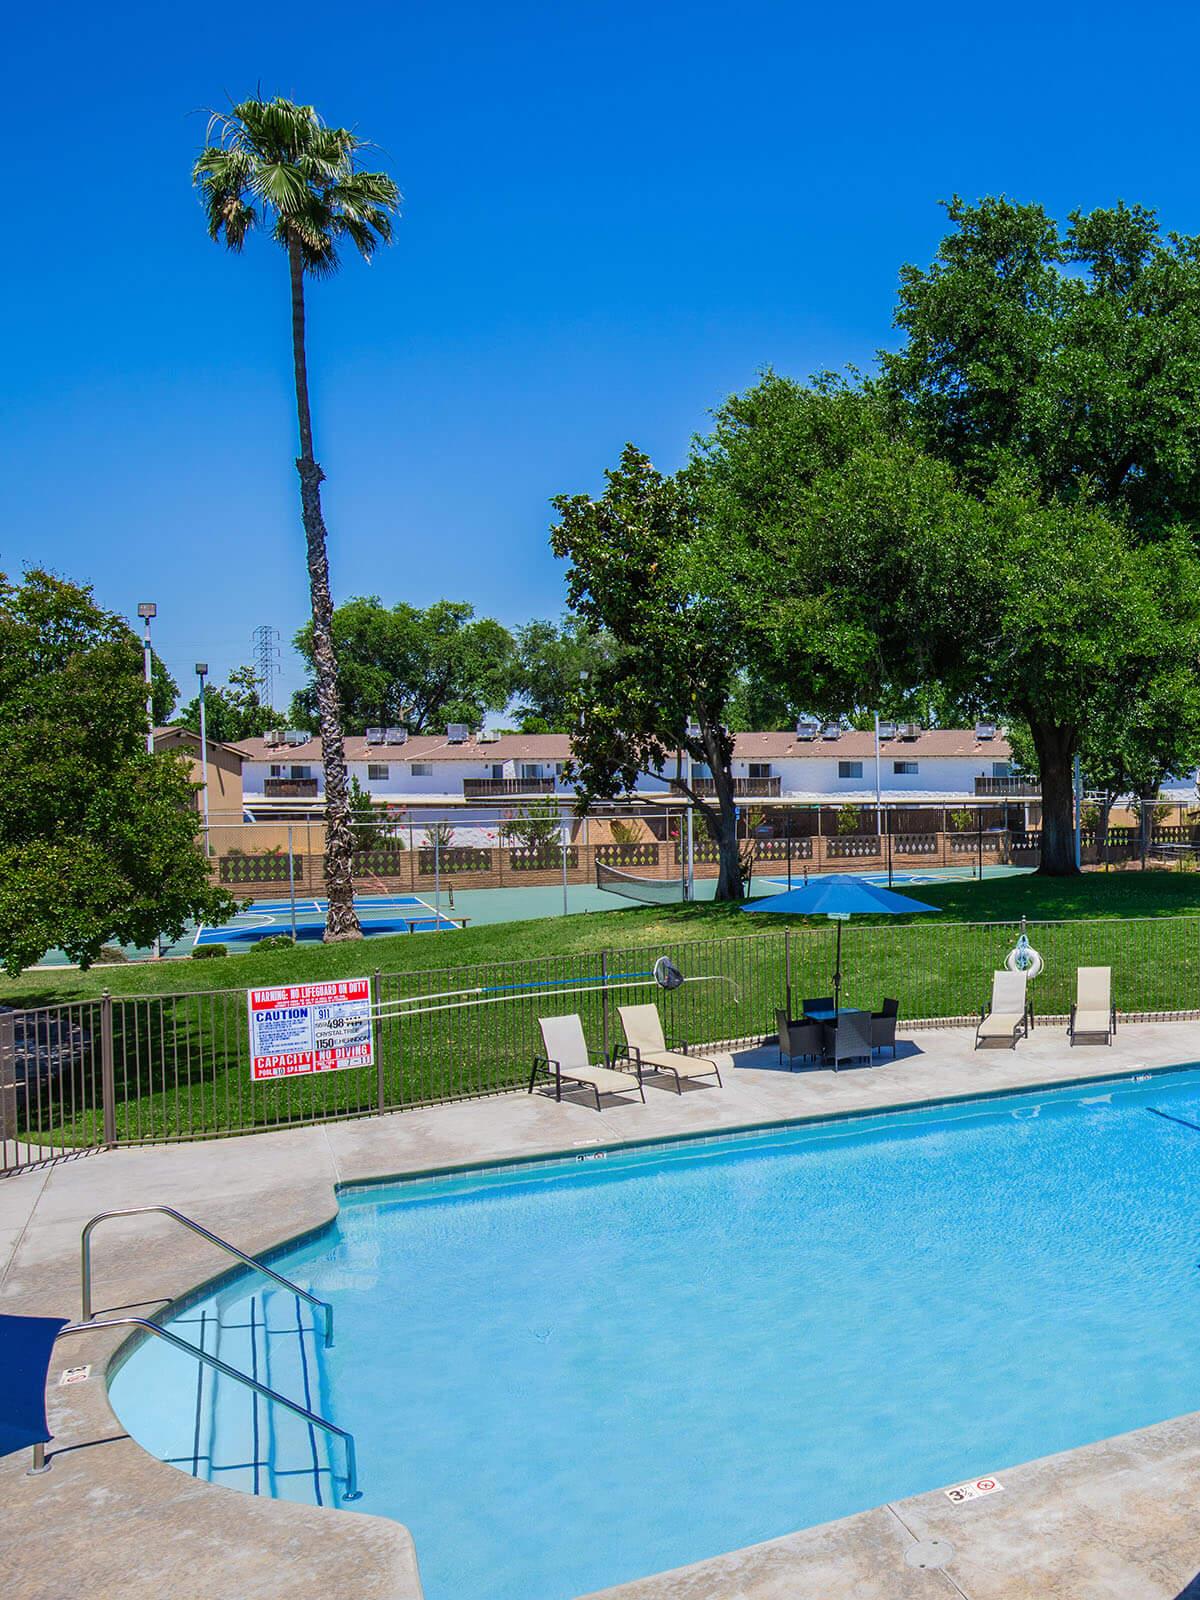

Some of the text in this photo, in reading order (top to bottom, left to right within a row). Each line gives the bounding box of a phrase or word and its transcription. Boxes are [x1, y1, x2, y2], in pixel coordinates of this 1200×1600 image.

[254, 990, 289, 1003] WARNING:
[290, 988, 300, 998] NO
[301, 985, 336, 998] LIFEGUARD
[338, 983, 348, 994] ON
[349, 981, 366, 993] DUTY
[256, 1008, 308, 1022] CAUTION
[318, 1008, 330, 1019] 911
[327, 1018, 344, 1029] 498
[316, 1038, 334, 1049] 1150
[319, 1045, 367, 1060] NO DIVING
[257, 1052, 311, 1068] CAPACITY
